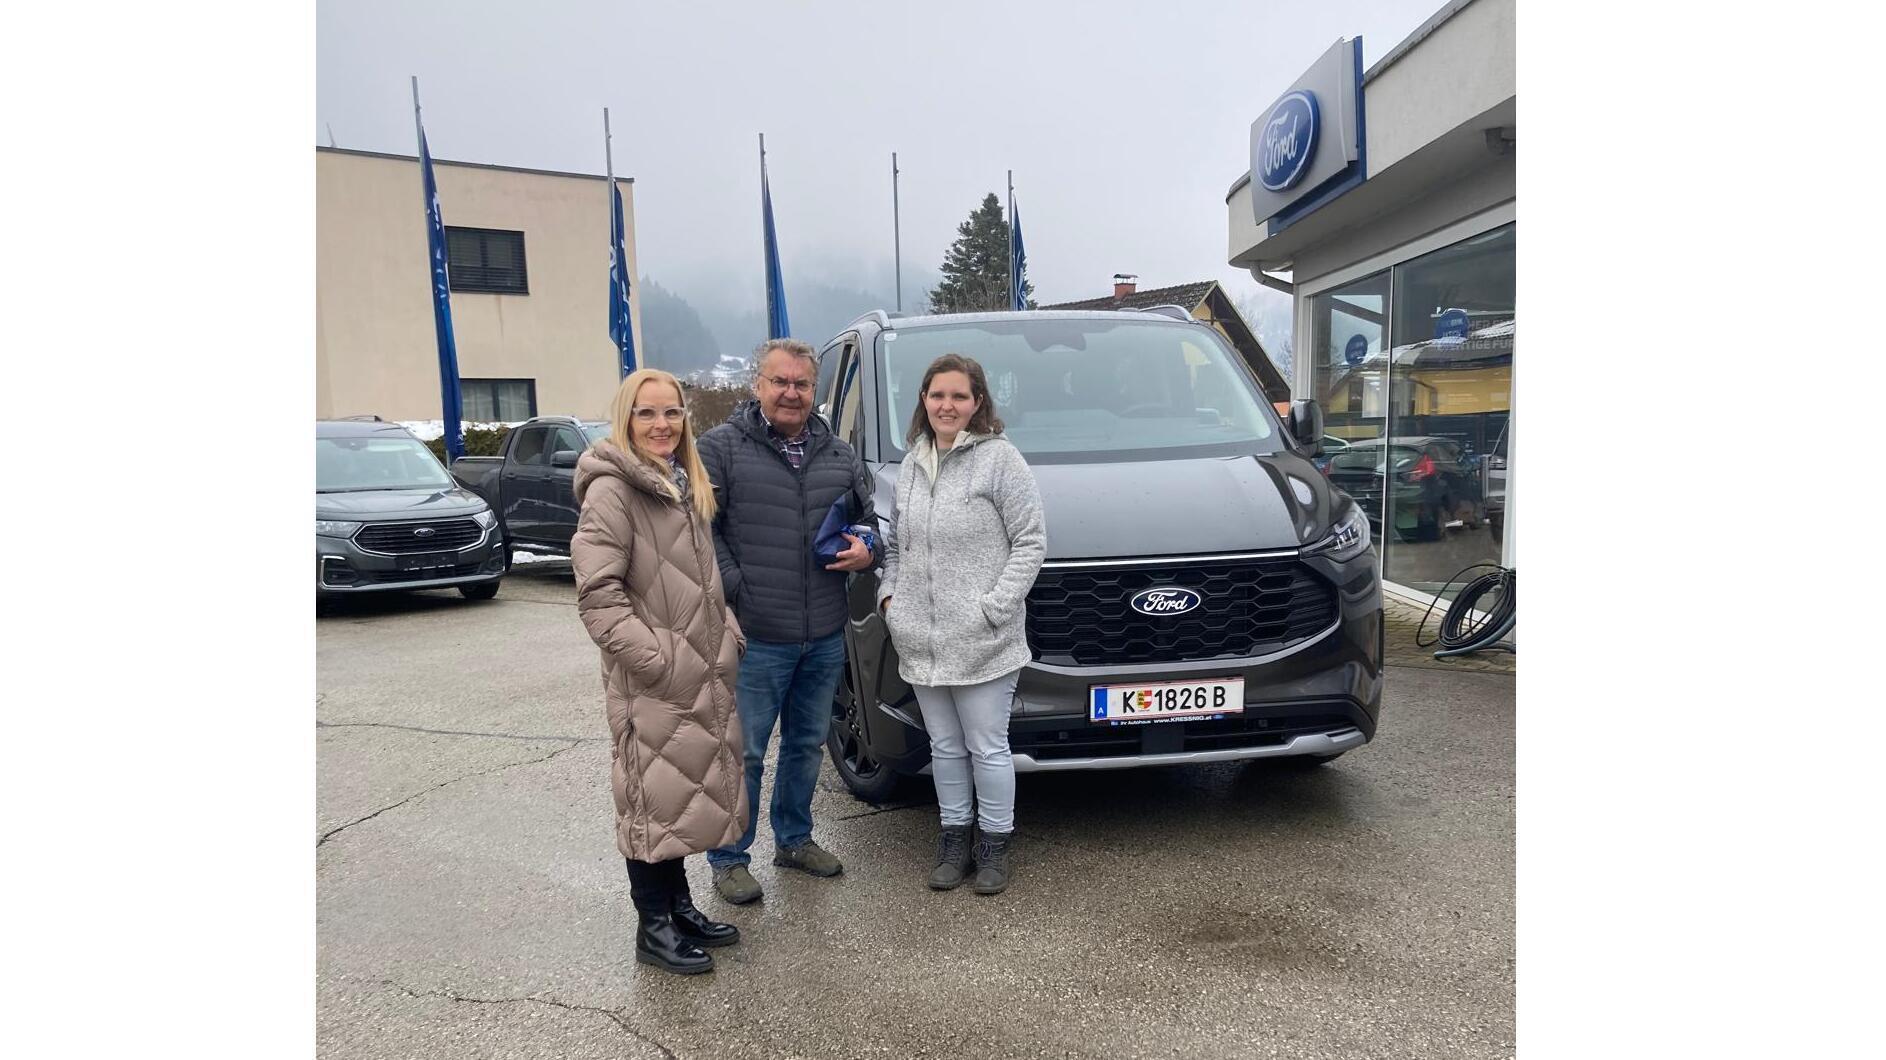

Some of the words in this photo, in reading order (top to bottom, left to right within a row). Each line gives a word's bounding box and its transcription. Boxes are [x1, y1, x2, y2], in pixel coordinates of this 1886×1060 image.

[1264, 110, 1298, 176] Ford
[1143, 592, 1189, 611] Ford
[1122, 691, 1136, 713] K
[1154, 686, 1207, 711] 1826
[1213, 686, 1226, 707] B
